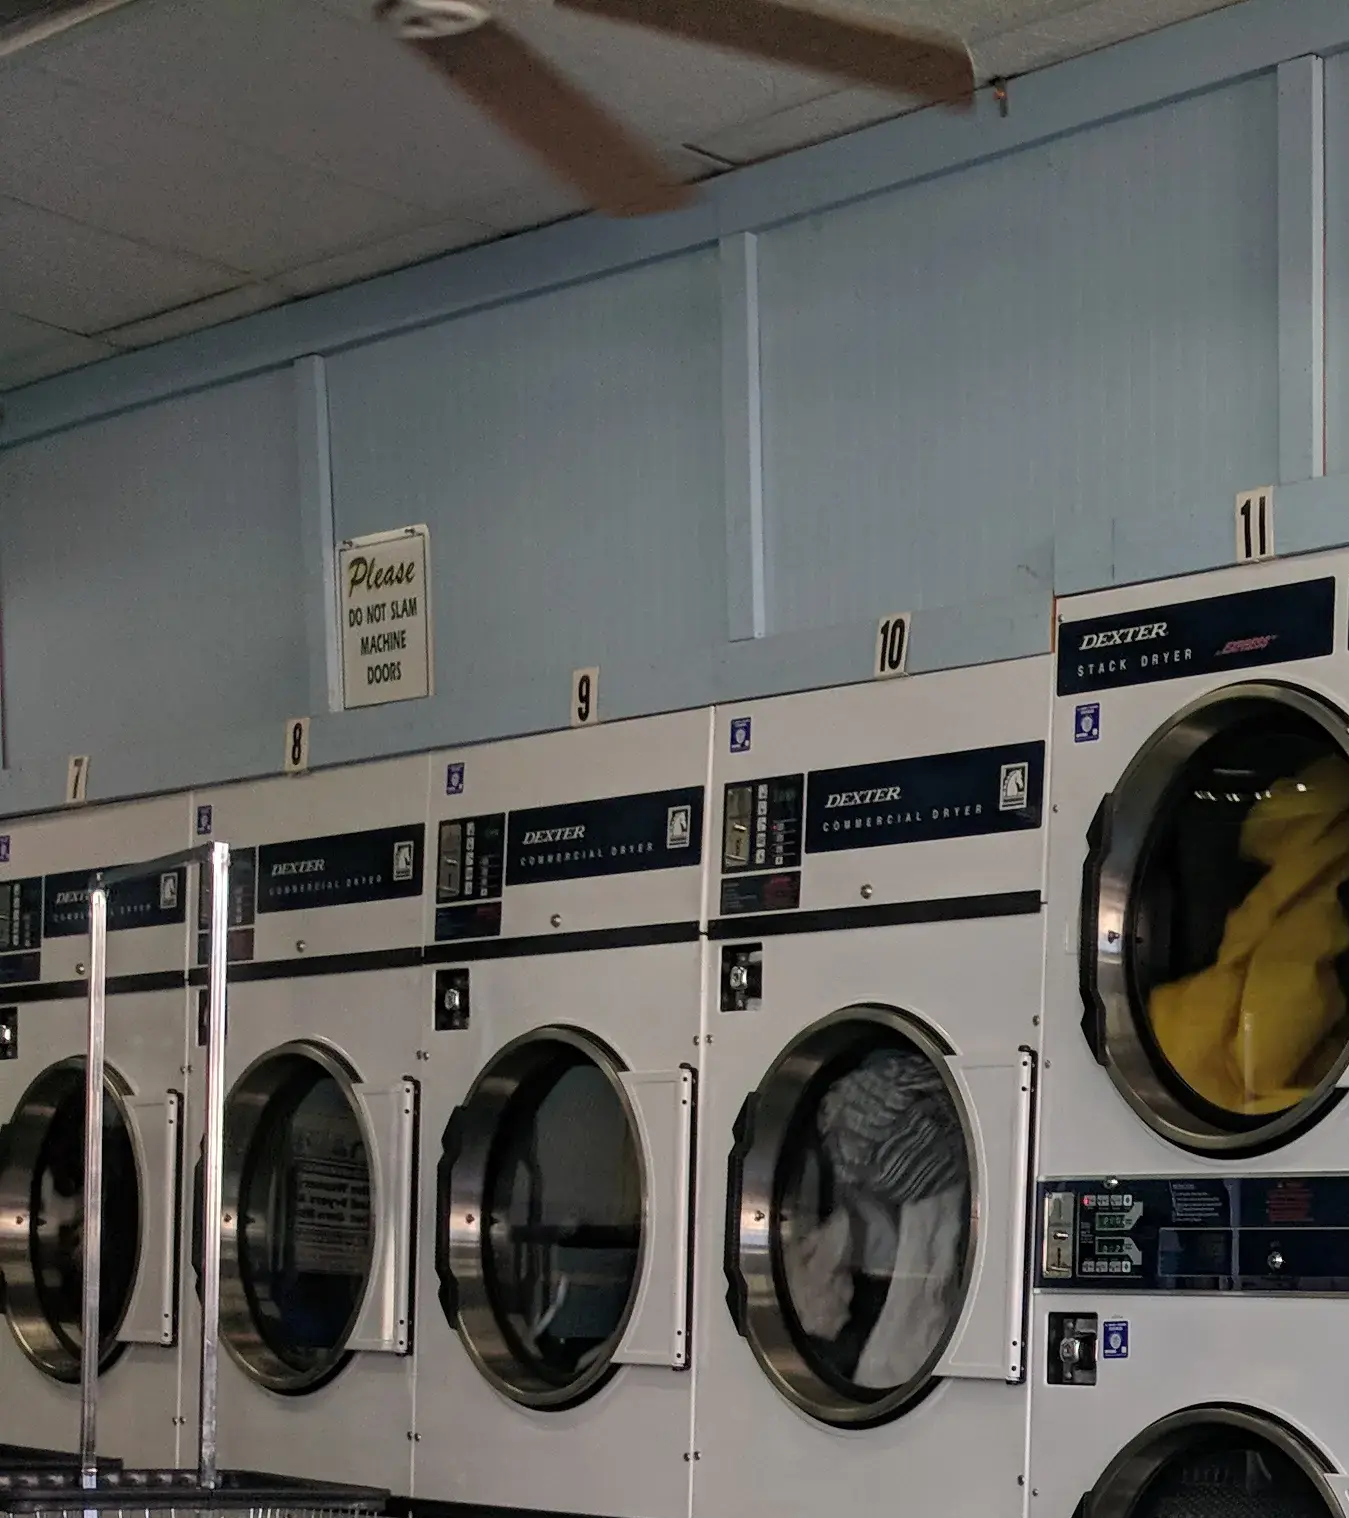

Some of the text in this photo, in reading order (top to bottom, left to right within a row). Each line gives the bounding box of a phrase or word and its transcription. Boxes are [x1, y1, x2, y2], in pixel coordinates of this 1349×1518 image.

[1240, 496, 1266, 558] 11
[348, 556, 416, 598] Please
[348, 597, 418, 628] DO NOT SLAM
[360, 629, 407, 656] MACHINE
[879, 618, 906, 672] 10
[1079, 622, 1169, 651] DEXTER
[367, 661, 402, 685] DOORS
[1077, 648, 1193, 677] STACK DRYER
[576, 674, 592, 723] 9
[292, 722, 303, 766] 8
[72, 757, 84, 799] 7
[825, 786, 901, 809] DEXTER
[822, 804, 983, 832] COMMERCIAL DRYER
[521, 825, 586, 846] DEXTER
[270, 859, 326, 877] DEXTER
[519, 842, 654, 867] COMMERCIAL DRYER
